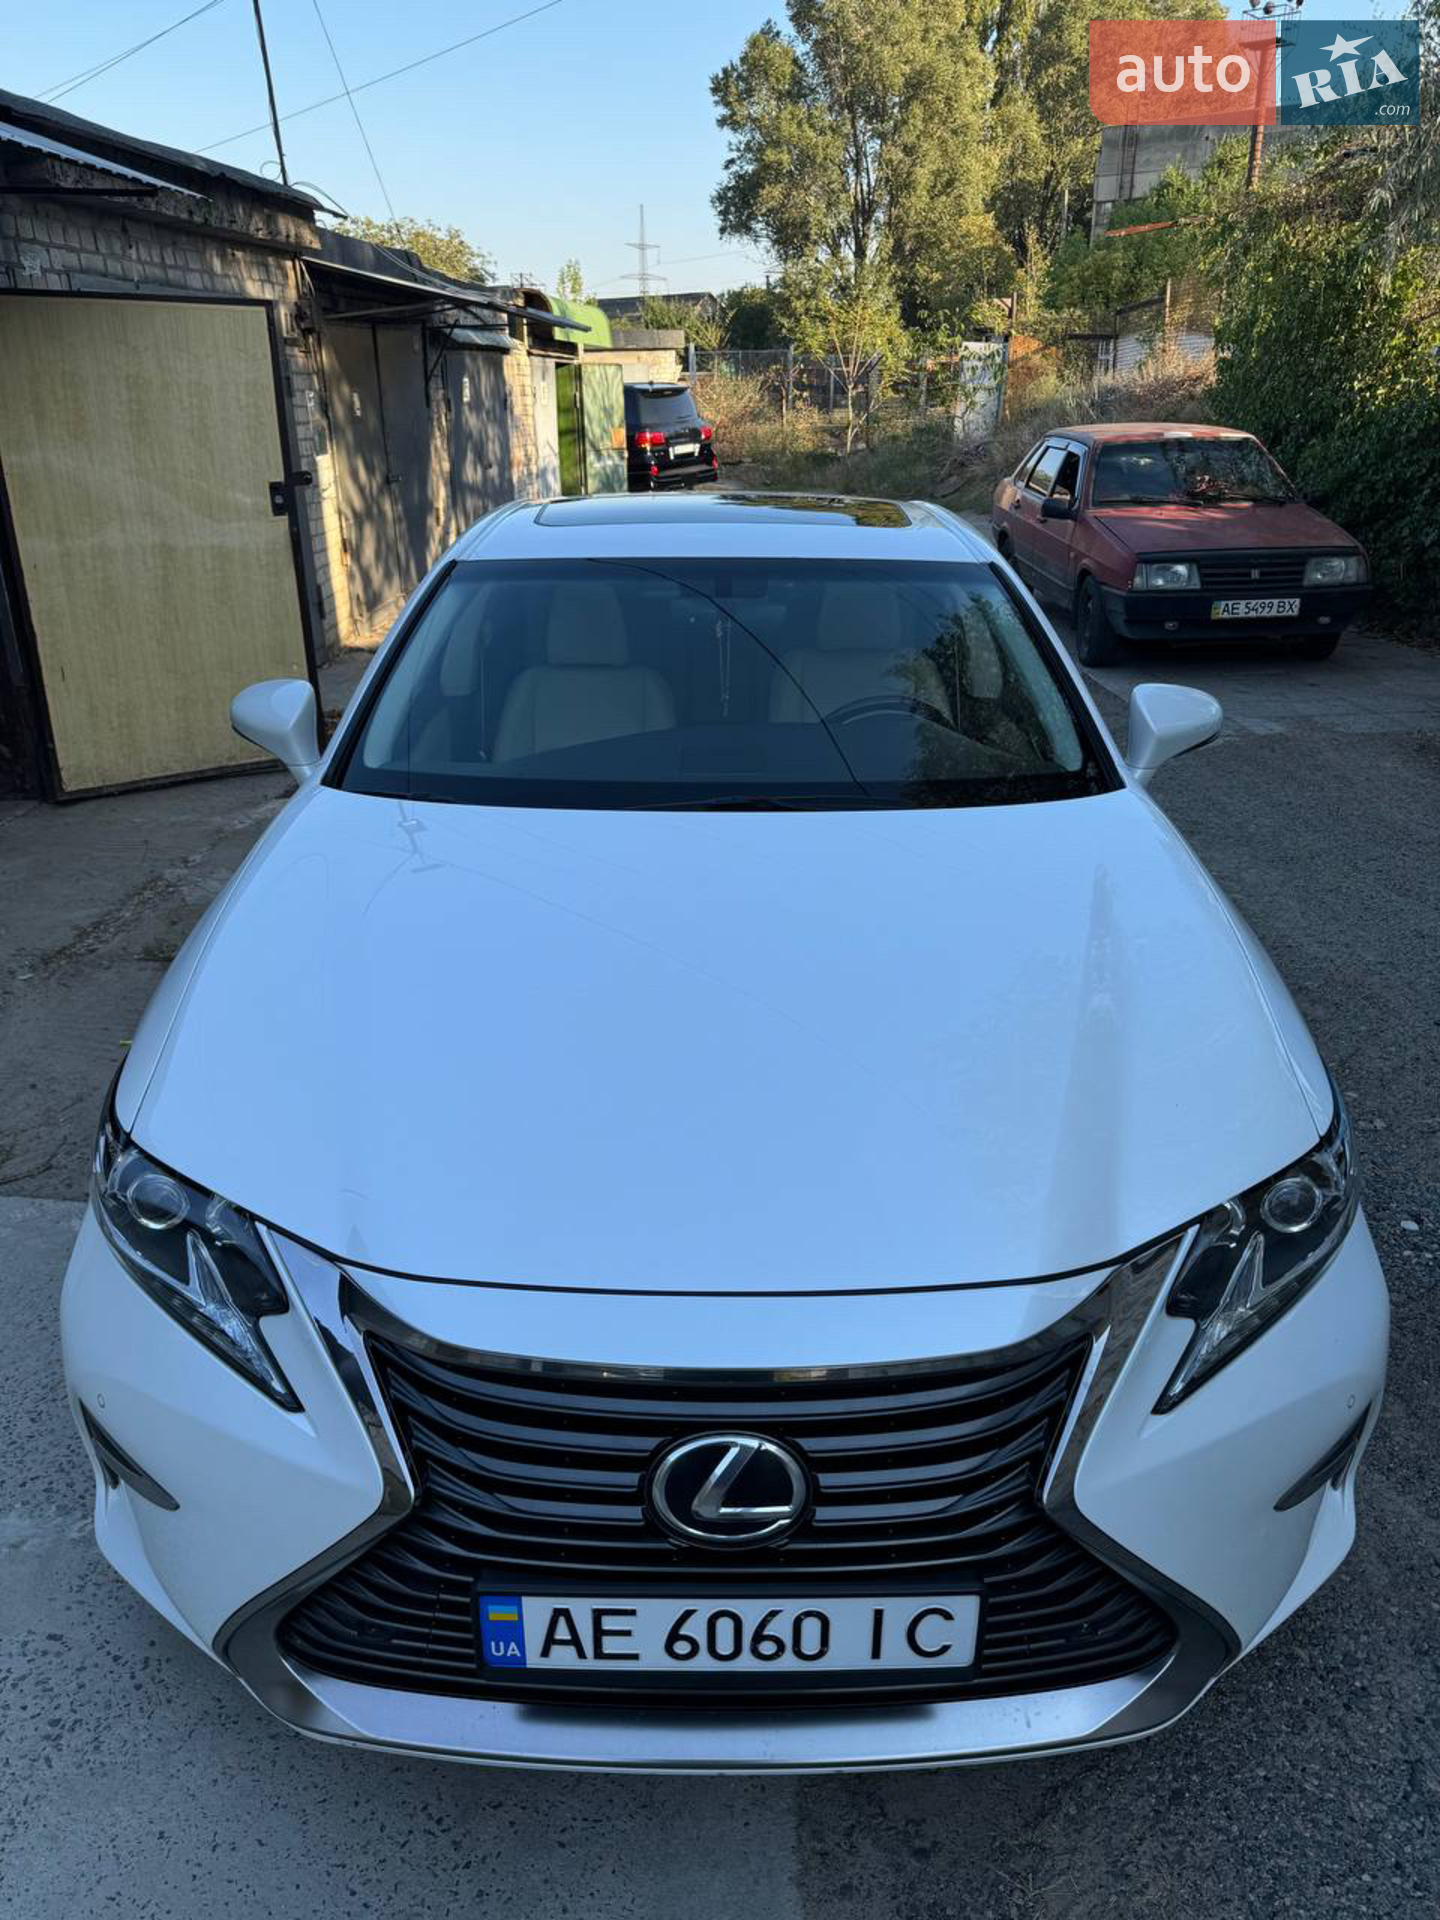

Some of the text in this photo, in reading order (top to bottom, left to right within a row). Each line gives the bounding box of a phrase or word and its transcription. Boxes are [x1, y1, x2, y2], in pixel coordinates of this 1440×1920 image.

[1222, 600, 1297, 616] AE 5499 BX
[540, 1607, 640, 1660] AE
[664, 1609, 830, 1661] 6060
[491, 1641, 521, 1657] UA
